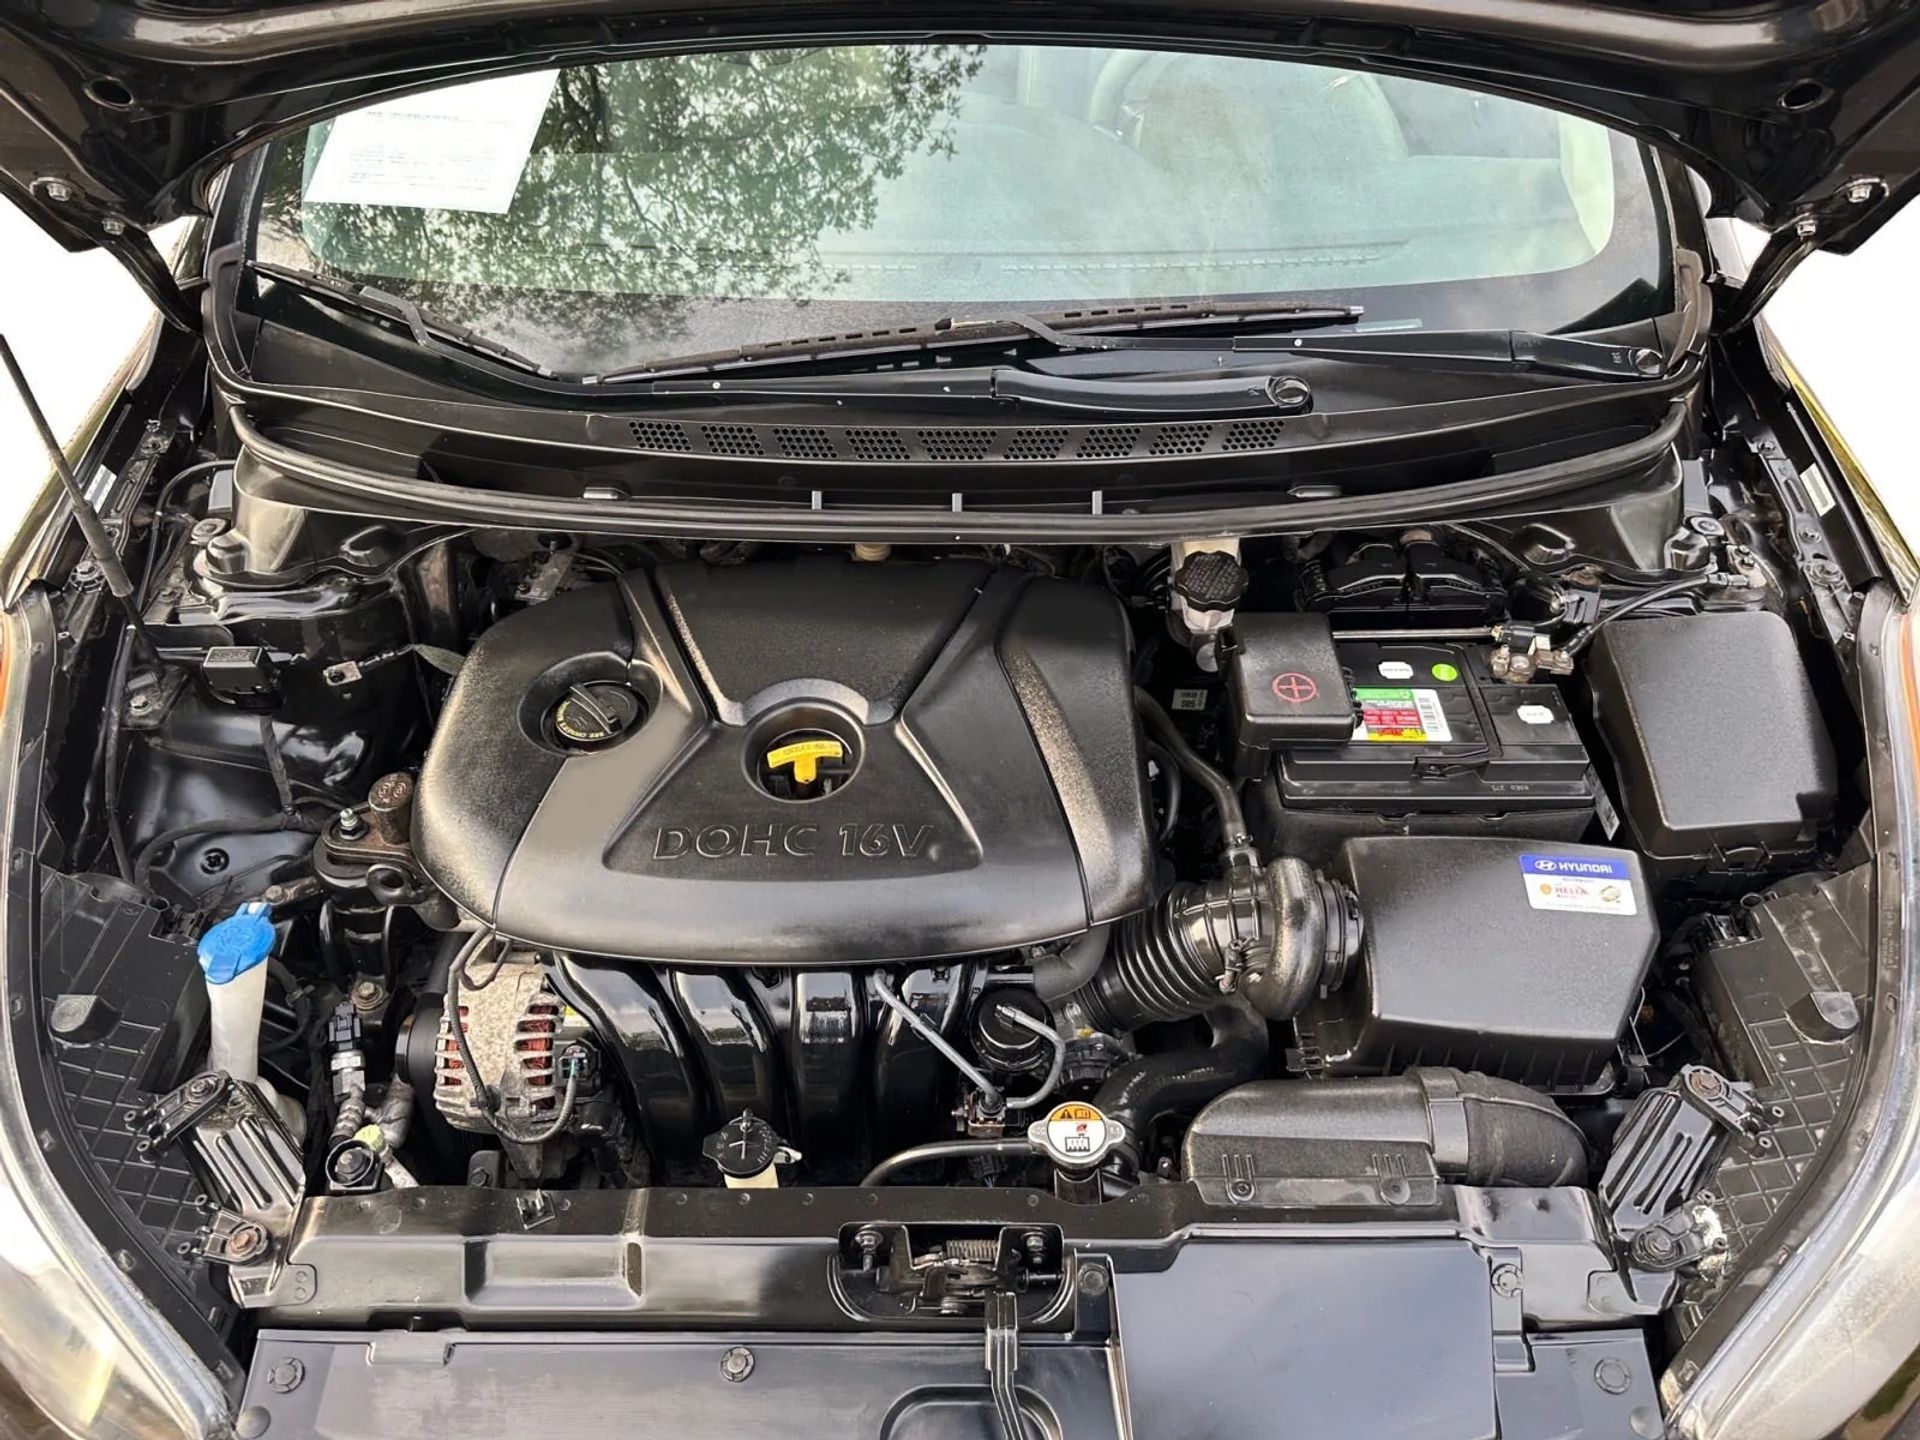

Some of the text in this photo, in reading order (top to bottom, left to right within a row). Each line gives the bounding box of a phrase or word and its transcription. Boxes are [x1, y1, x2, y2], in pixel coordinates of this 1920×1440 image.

[652, 822, 935, 860] DOHC 16V
[1558, 862, 1613, 874] HYUNDAI
